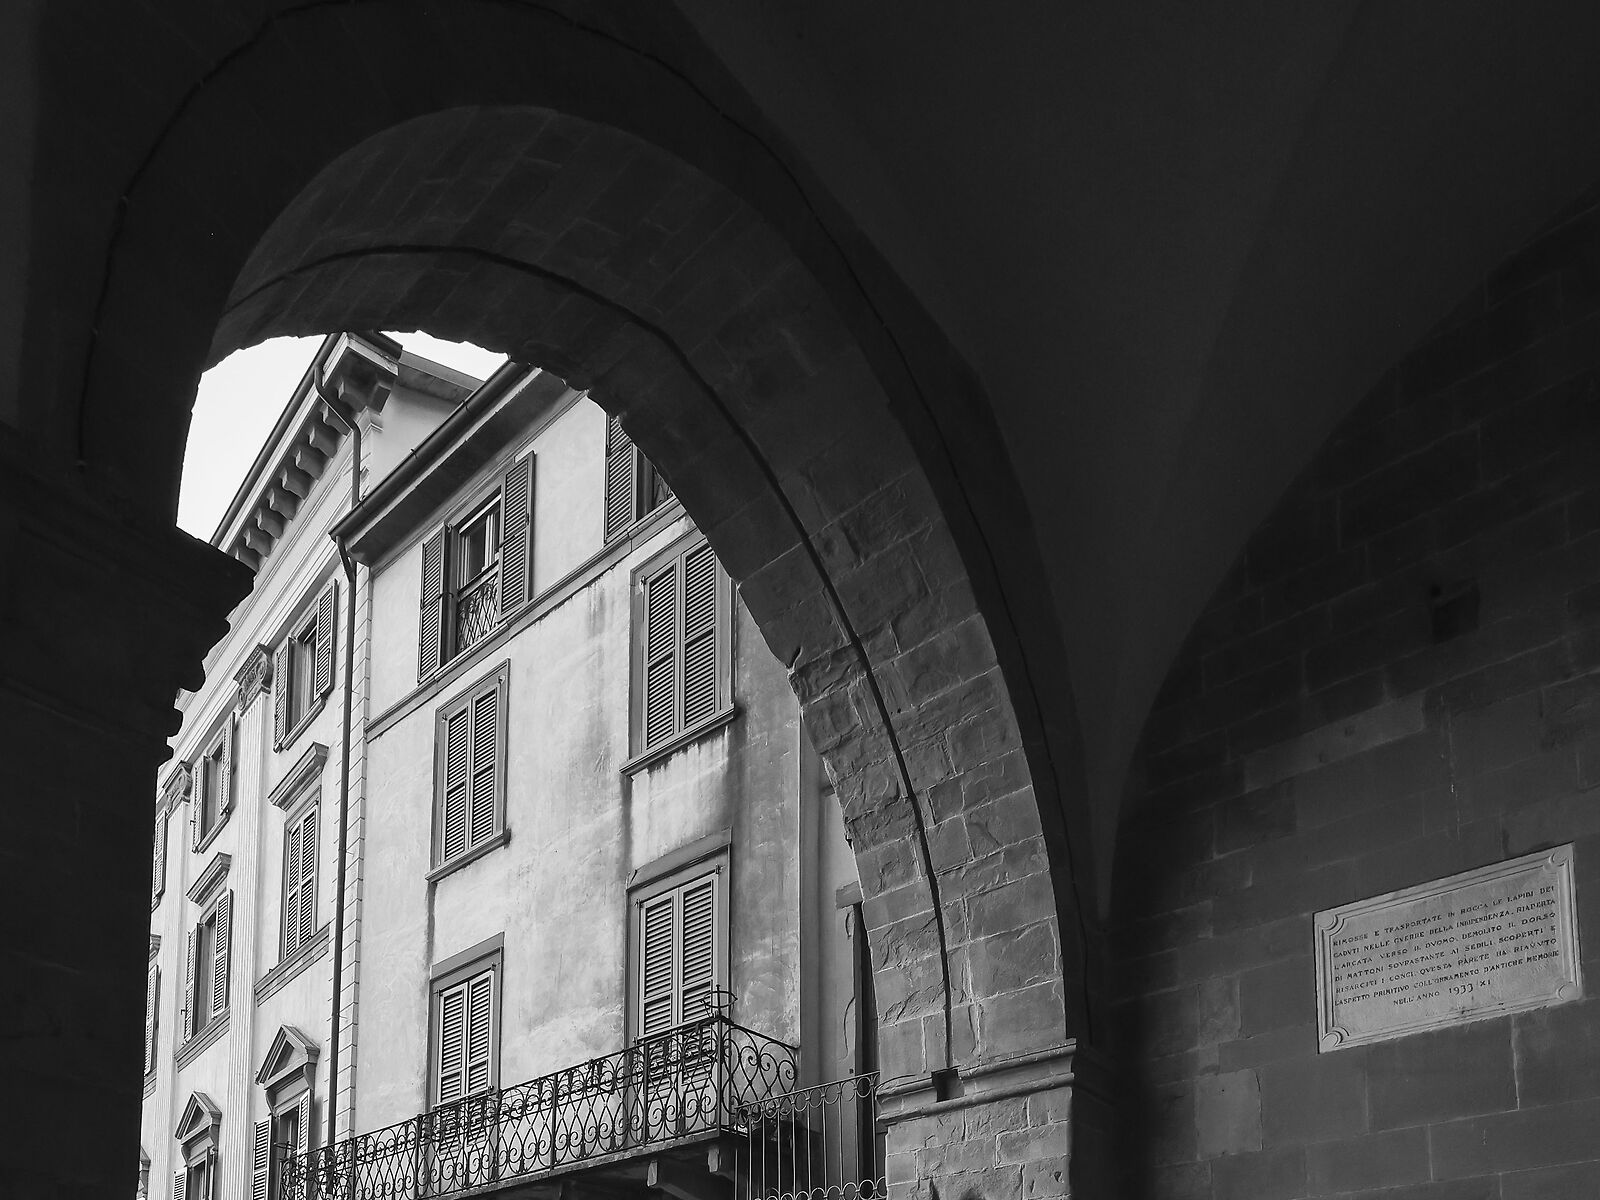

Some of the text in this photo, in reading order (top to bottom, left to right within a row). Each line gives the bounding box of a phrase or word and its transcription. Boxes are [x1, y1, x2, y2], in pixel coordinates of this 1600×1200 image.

[1384, 915, 1442, 933] TRASPORTATE
[1507, 890, 1534, 902] LAPIDI
[1540, 885, 1554, 894] DEI
[1347, 966, 1383, 979] MATTONI
[1388, 951, 1445, 970] SOVRASTANTE
[1498, 928, 1543, 943] SCOPERTI
[1364, 941, 1390, 951] NELLE
[1430, 925, 1453, 935] DELLA
[1380, 948, 1407, 958] VERSO
[1462, 925, 1502, 940] DEMOLITO
[1521, 912, 1555, 925] DORSO
[1336, 979, 1377, 994] RISARCITI
[1458, 953, 1490, 966] PARETE
[1373, 984, 1410, 997] PRIMITIVO
[1484, 958, 1523, 973] D'ANTICHE
[1526, 950, 1559, 963] MEMORIE
[1449, 983, 1474, 996] 1933
[1480, 979, 1491, 987] XI
